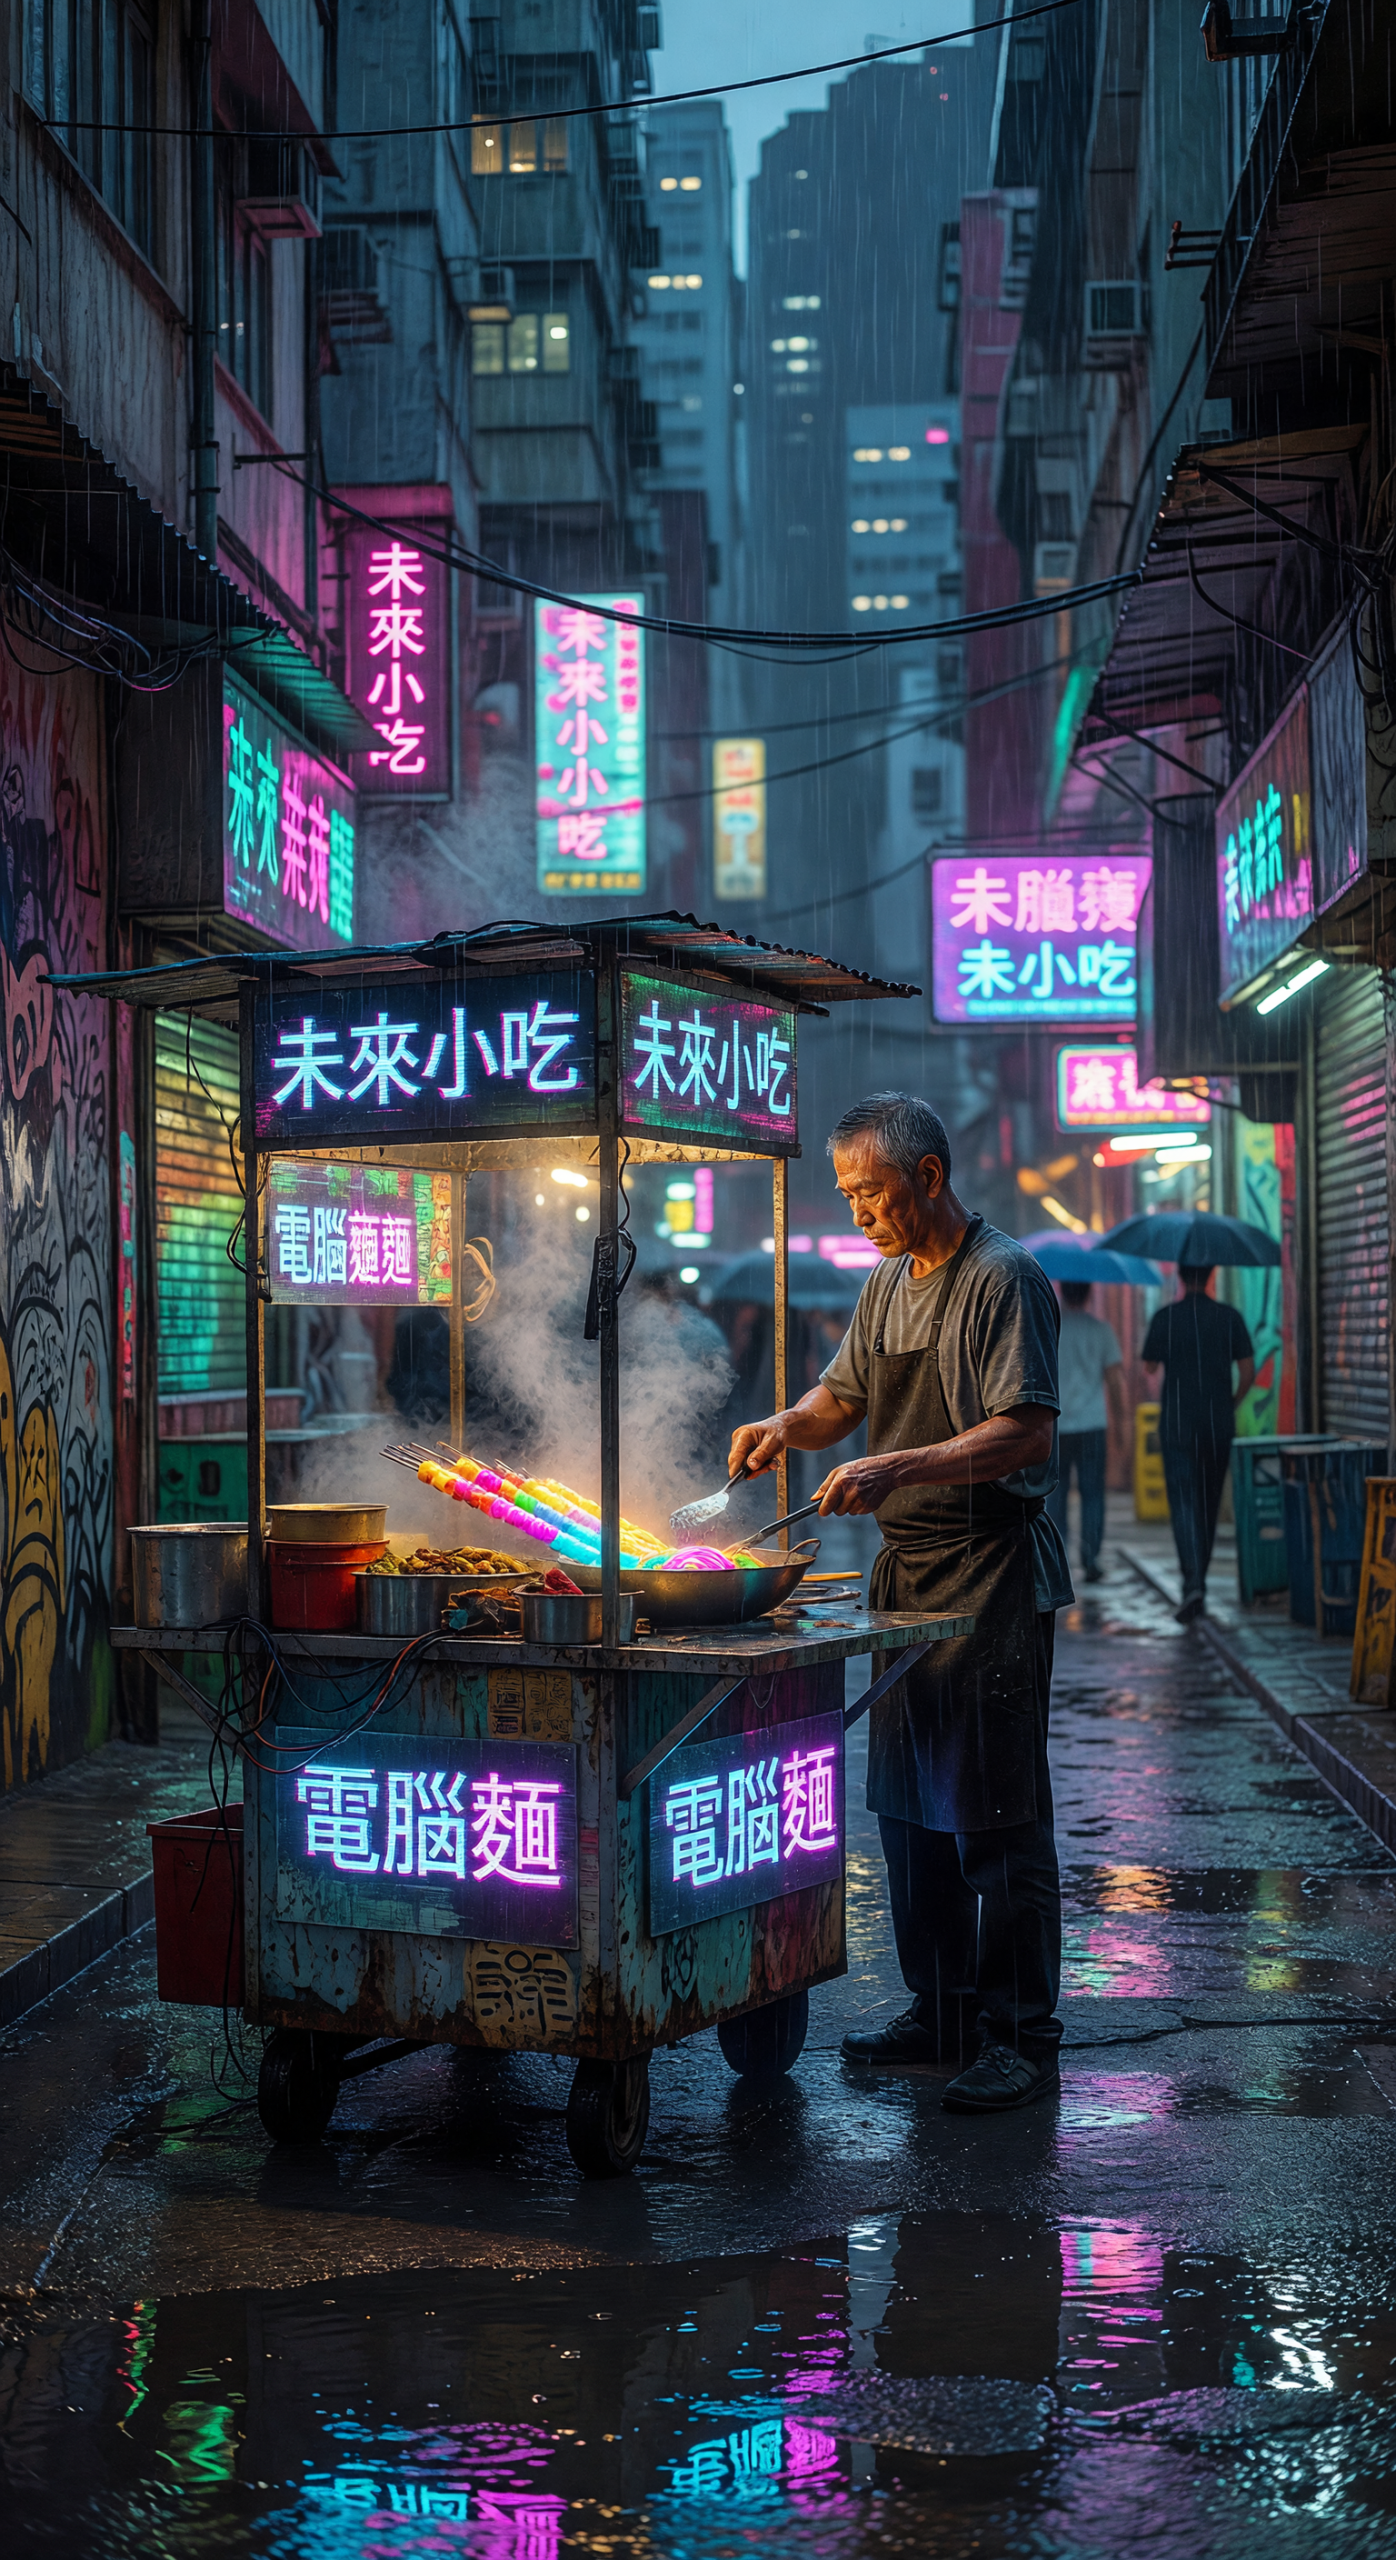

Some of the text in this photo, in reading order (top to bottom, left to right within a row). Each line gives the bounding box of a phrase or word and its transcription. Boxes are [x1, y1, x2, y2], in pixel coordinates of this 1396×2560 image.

[366, 541, 426, 774] 未來小吃
[957, 939, 1137, 998] 未小吃
[271, 1000, 581, 1110] 未來小吃
[633, 1000, 791, 1115] 未來小吃
[295, 1765, 561, 1889] 電腦麵
[665, 1747, 837, 1888] 電腦麵
